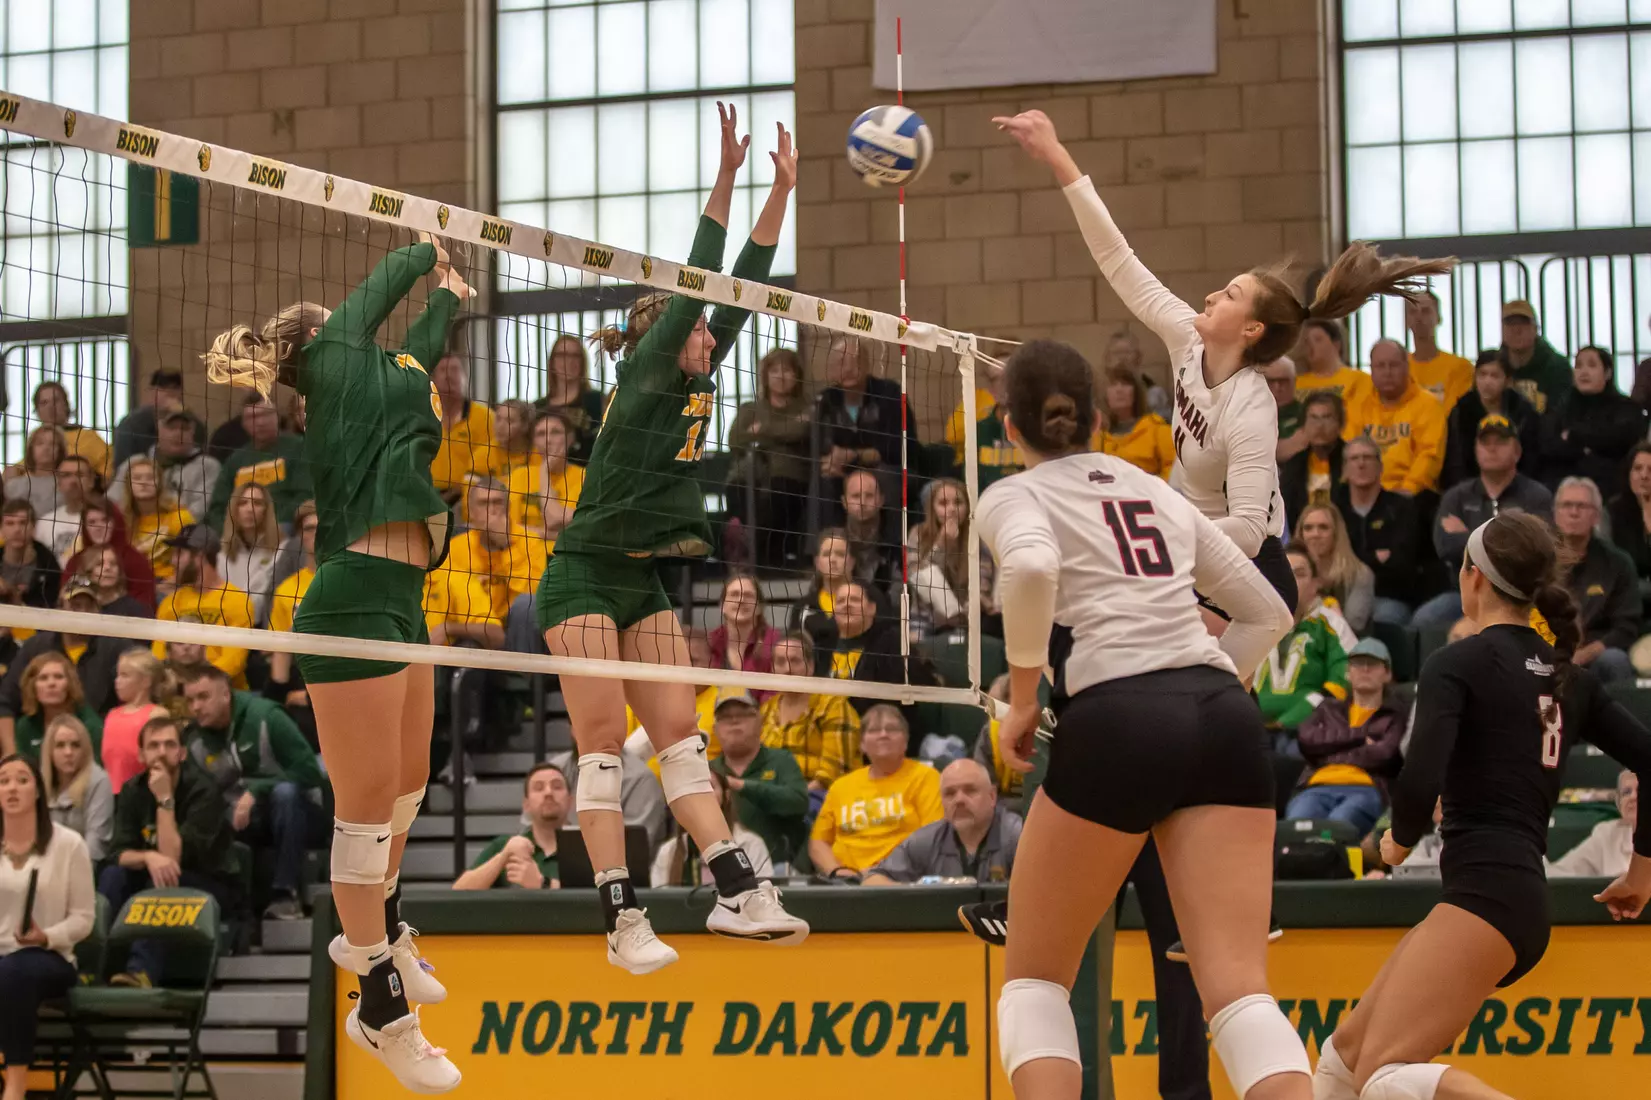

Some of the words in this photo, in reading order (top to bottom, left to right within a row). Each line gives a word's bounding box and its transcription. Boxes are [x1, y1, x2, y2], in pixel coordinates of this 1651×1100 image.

[116, 128, 159, 158] BISON
[248, 162, 287, 190] BISON
[369, 192, 404, 219] BISON
[480, 220, 512, 245] BISON
[582, 246, 614, 270] BISON
[677, 269, 706, 292] BISON
[766, 291, 792, 312] BISON
[848, 312, 873, 332] BISON
[1175, 379, 1209, 449] OMAHA
[1102, 500, 1174, 577] 15
[1539, 694, 1562, 768] 8
[124, 903, 204, 927] BISON
[471, 1000, 694, 1056] NORTH
[712, 1000, 970, 1057] DAKOTA
